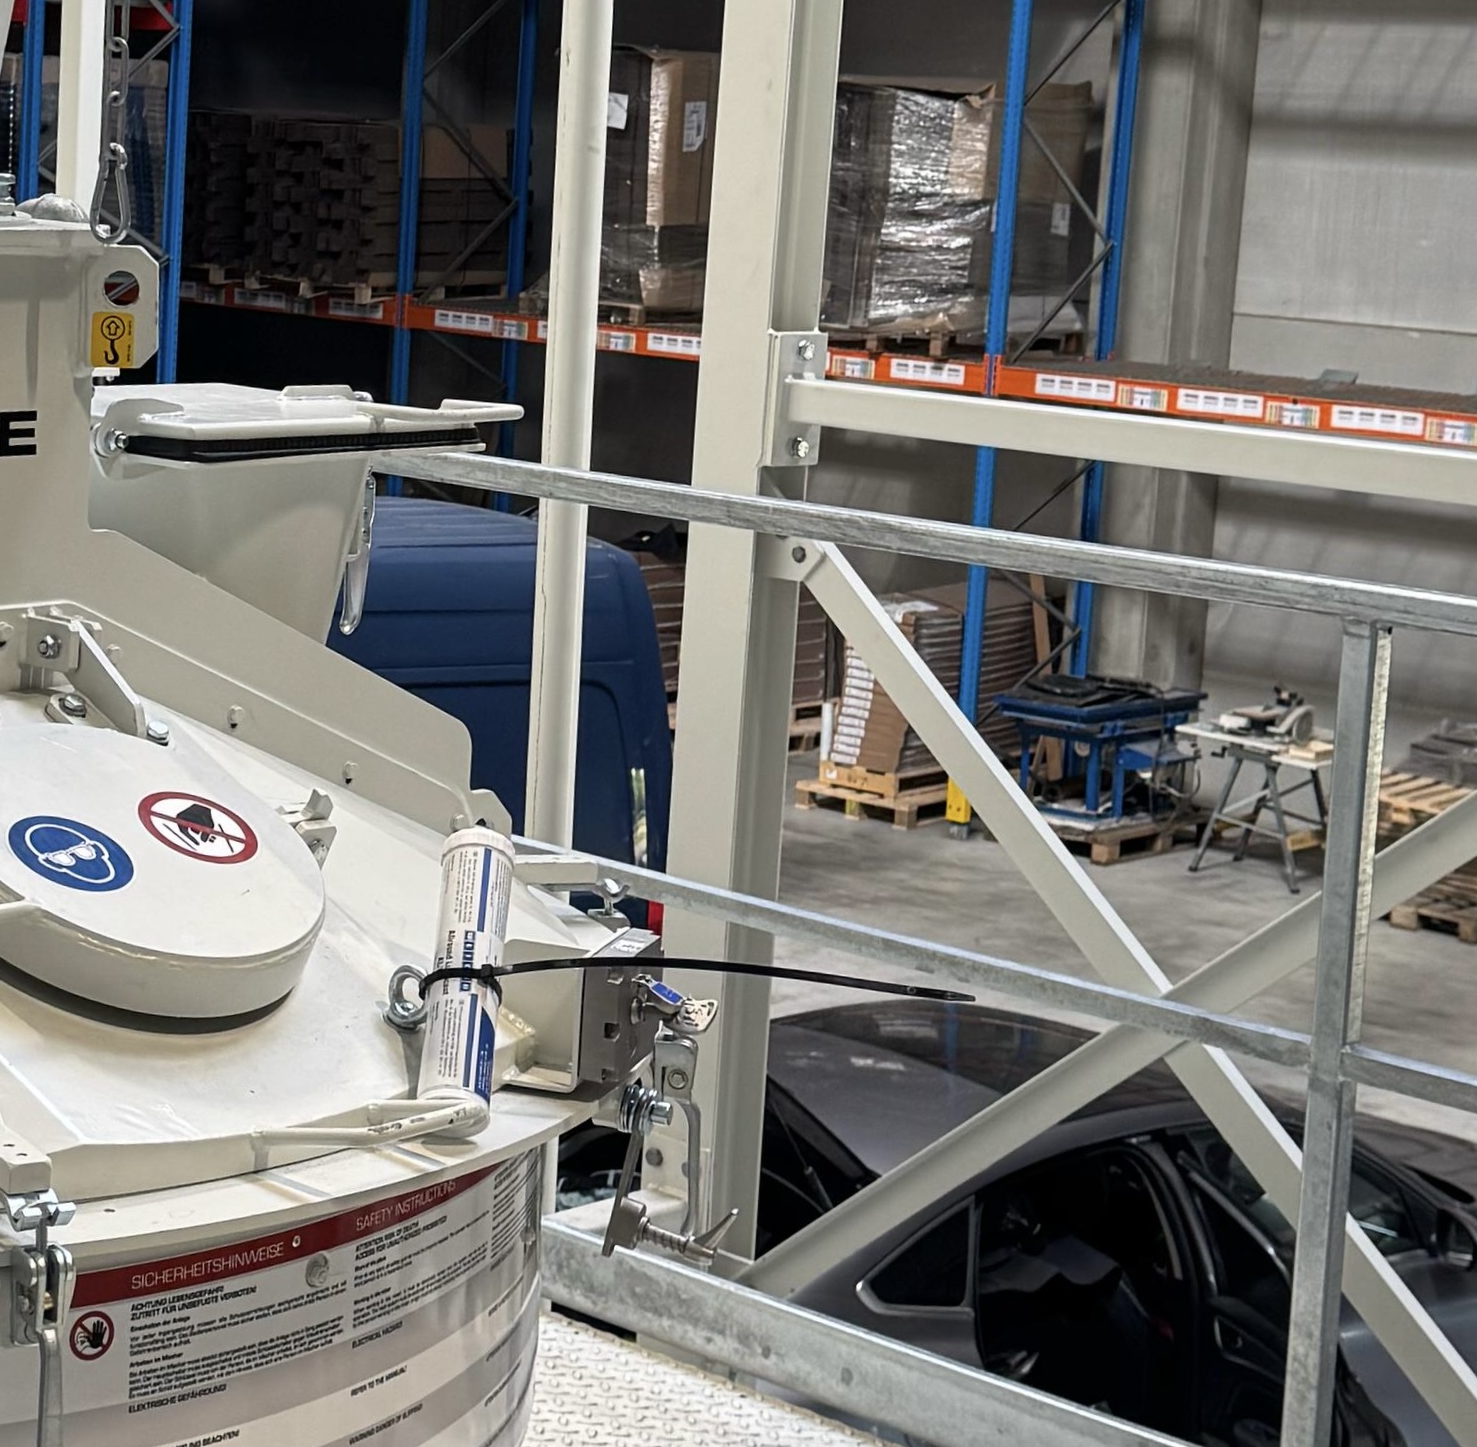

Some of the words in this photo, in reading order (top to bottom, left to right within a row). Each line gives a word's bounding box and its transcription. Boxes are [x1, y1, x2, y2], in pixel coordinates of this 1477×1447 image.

[356, 1207, 394, 1232] SAFETY
[395, 1180, 457, 1217] INSTRUCTIONS
[131, 1242, 285, 1290] SICHERHEITSHINWEISE
[131, 1297, 167, 1312] ACHTUNG
[130, 1306, 161, 1321] ZUTRITT
[128, 1397, 177, 1414] ELEKTRISCHE
